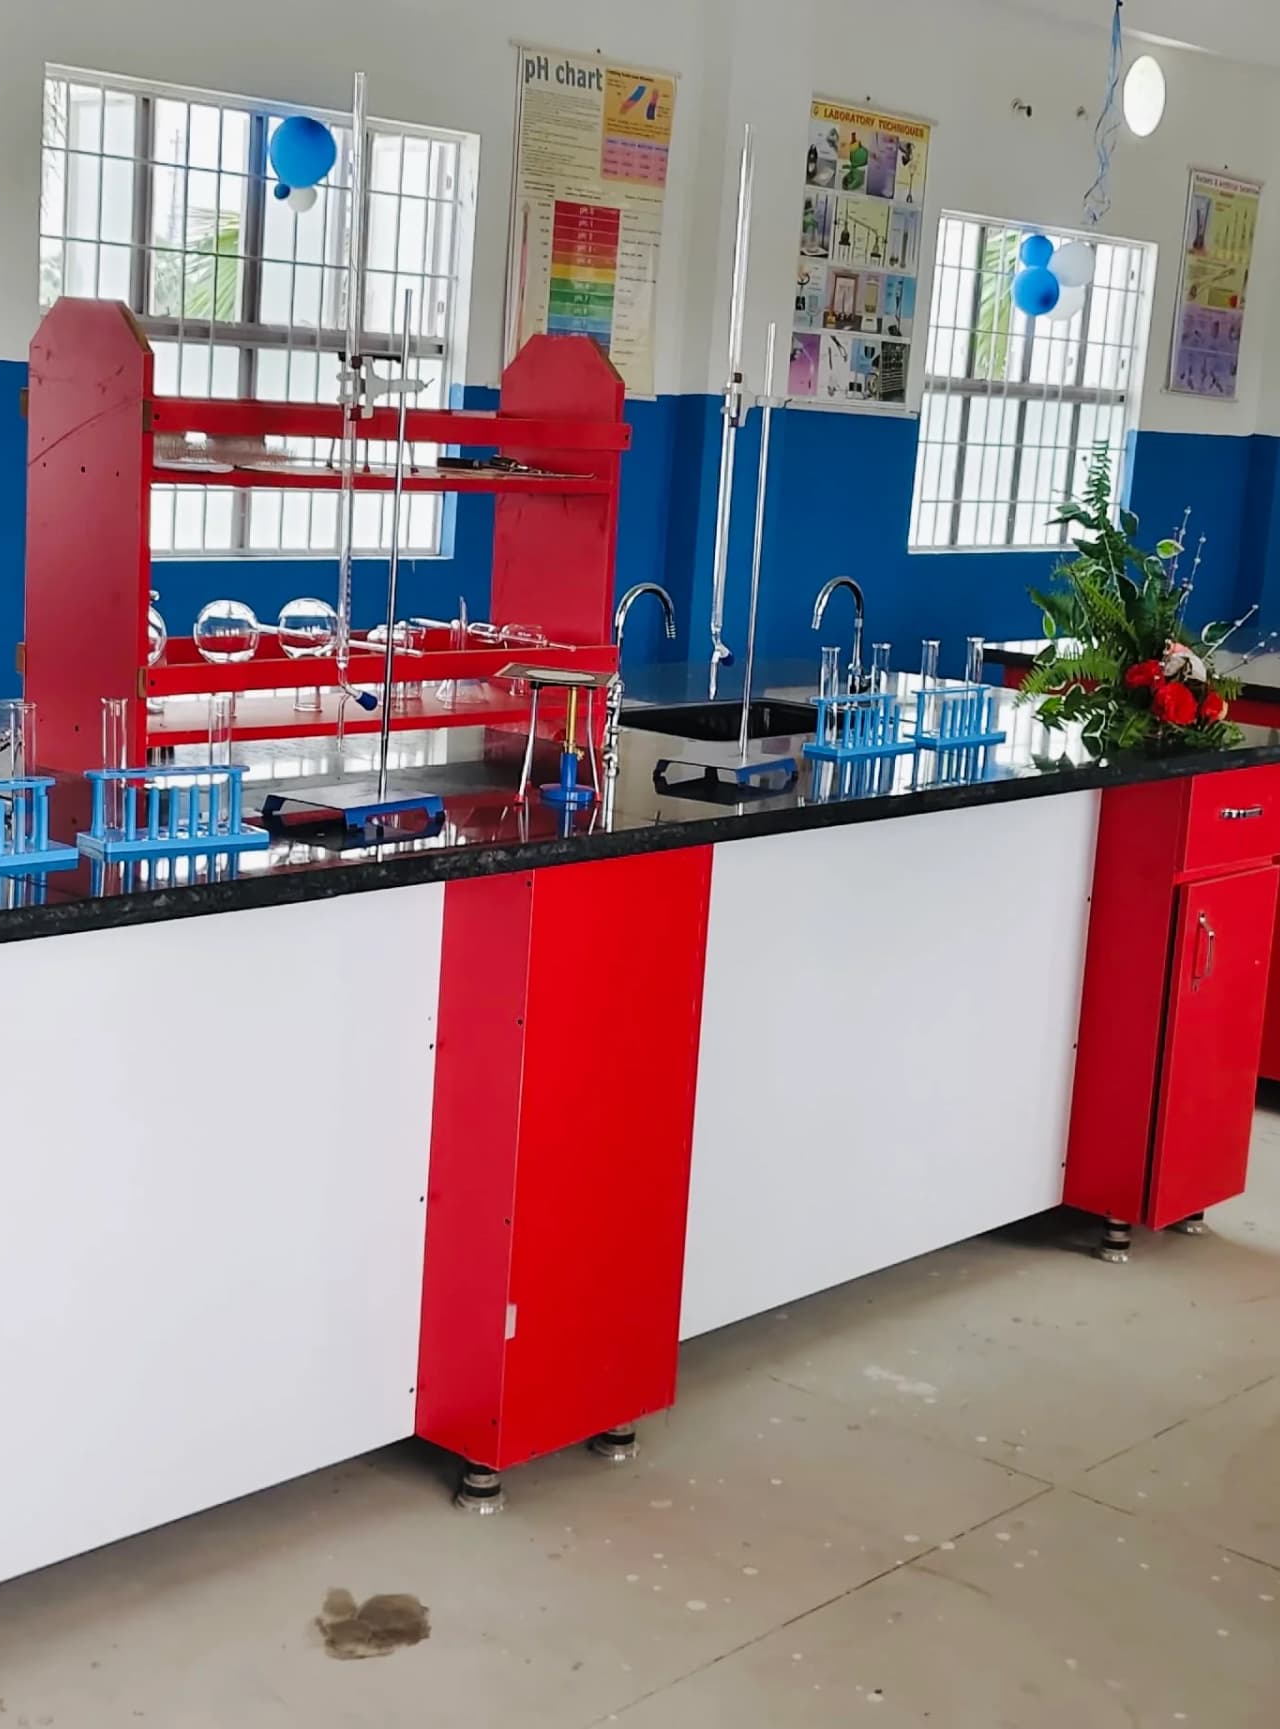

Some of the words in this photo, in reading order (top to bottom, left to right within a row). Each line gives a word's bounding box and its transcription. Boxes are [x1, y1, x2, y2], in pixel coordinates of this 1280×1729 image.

[525, 55, 548, 83] pH
[556, 60, 603, 92] chart
[824, 108, 875, 126] LABORATORY
[879, 119, 924, 138] TECHNIQUES
